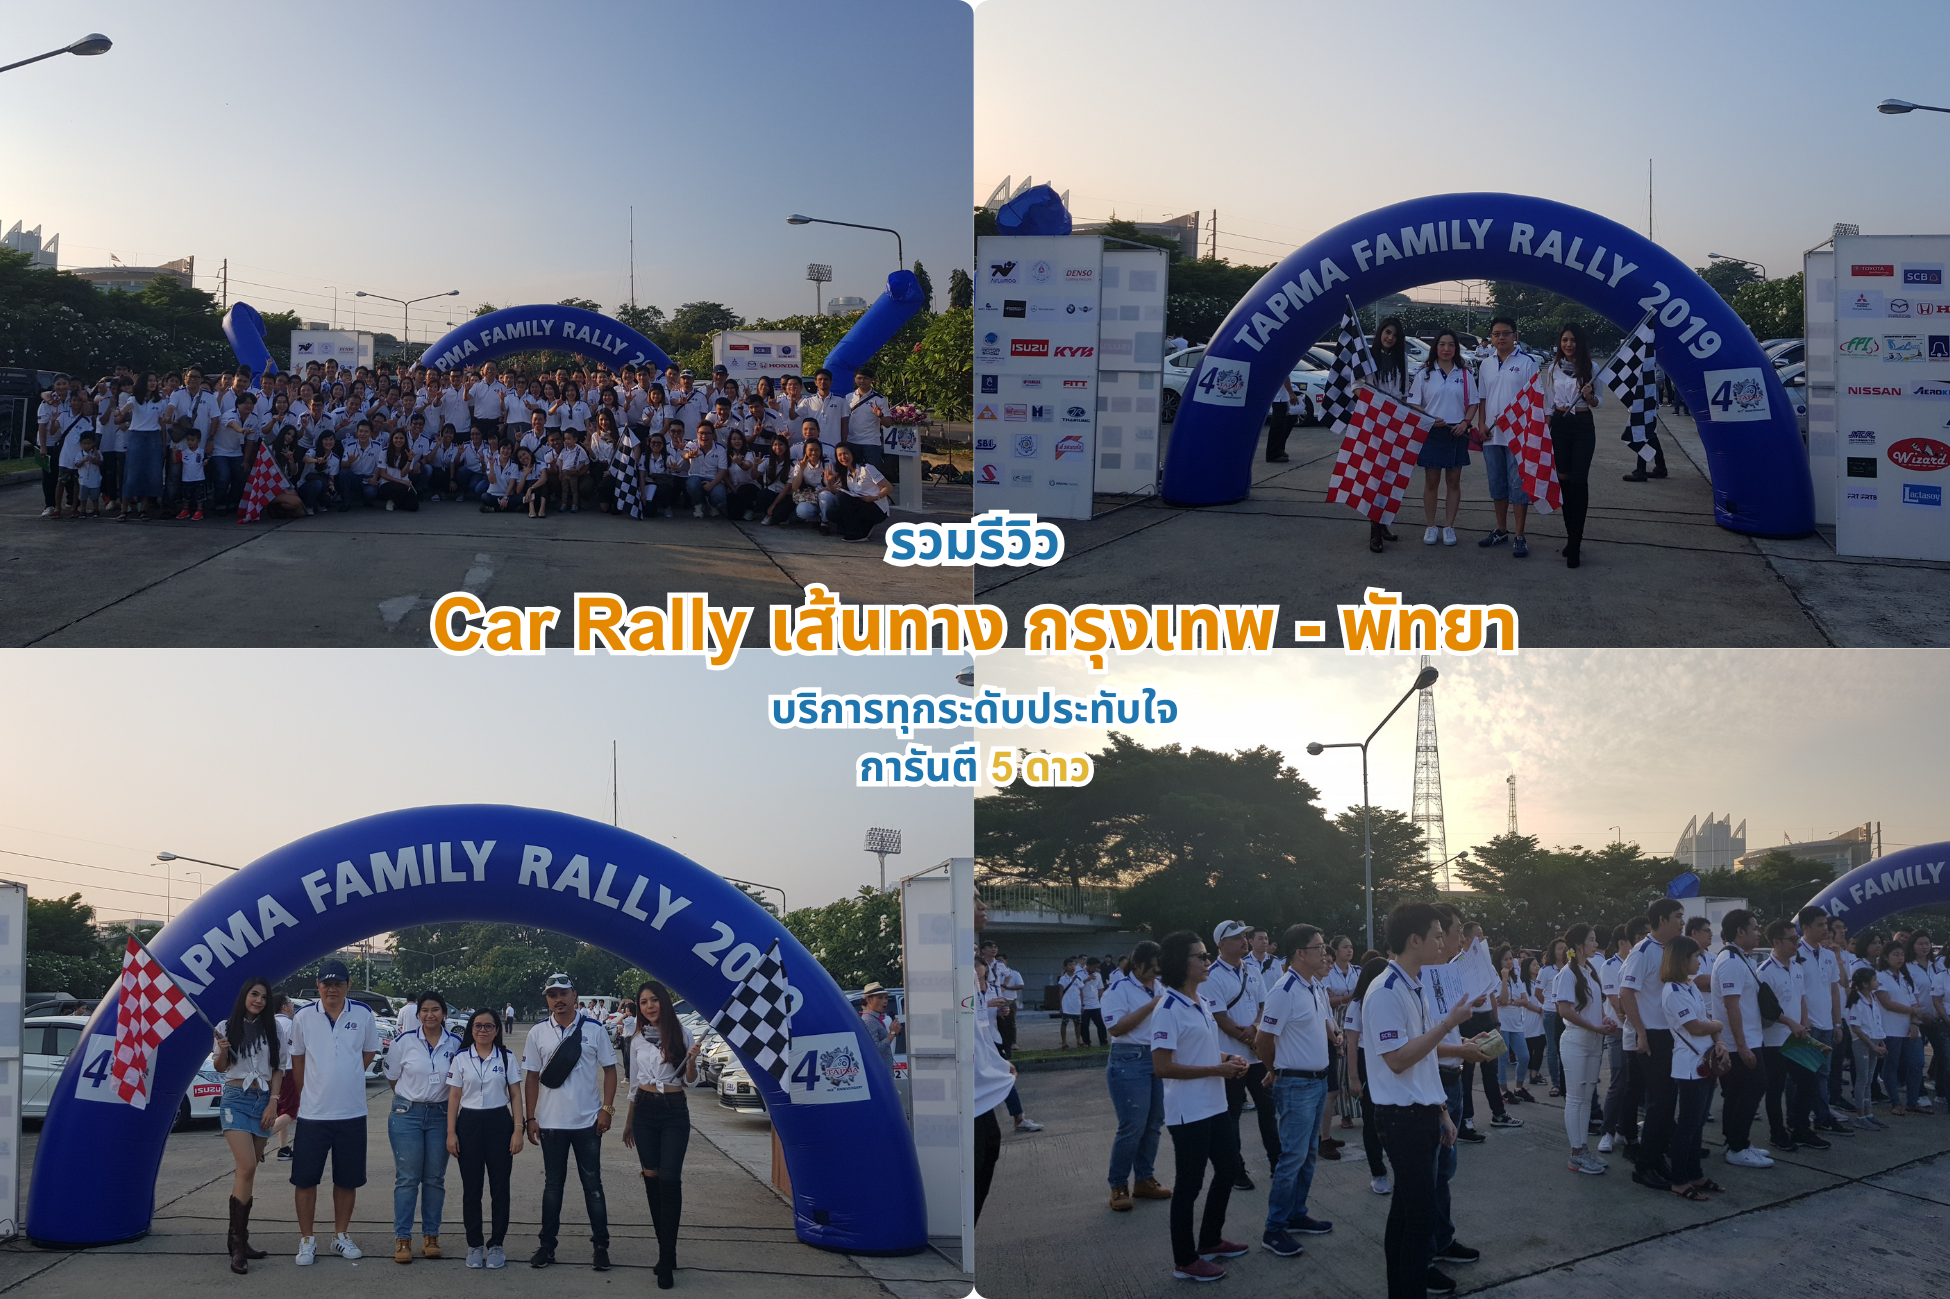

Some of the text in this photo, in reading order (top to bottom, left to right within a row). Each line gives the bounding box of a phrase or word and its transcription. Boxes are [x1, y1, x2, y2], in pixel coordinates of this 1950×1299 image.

[1066, 269, 1093, 277] DENSO
[1907, 272, 1928, 281] SCB
[1233, 218, 1723, 359] TAPMA FAMILY RALLY 2019
[434, 319, 629, 372] PMA FAMILY RALLY
[1012, 344, 1048, 352] ISUZU
[1053, 347, 1095, 358] KYB
[1848, 387, 1902, 396] NISSAN
[1893, 452, 1947, 466] Wizard
[1904, 487, 1941, 503] Lactasoy
[1849, 861, 1946, 905] FAMILY
[169, 893, 300, 998] APMA
[300, 839, 497, 915] FAMILY
[517, 844, 693, 932] RALLY
[826, 1068, 859, 1076] TAPMA
